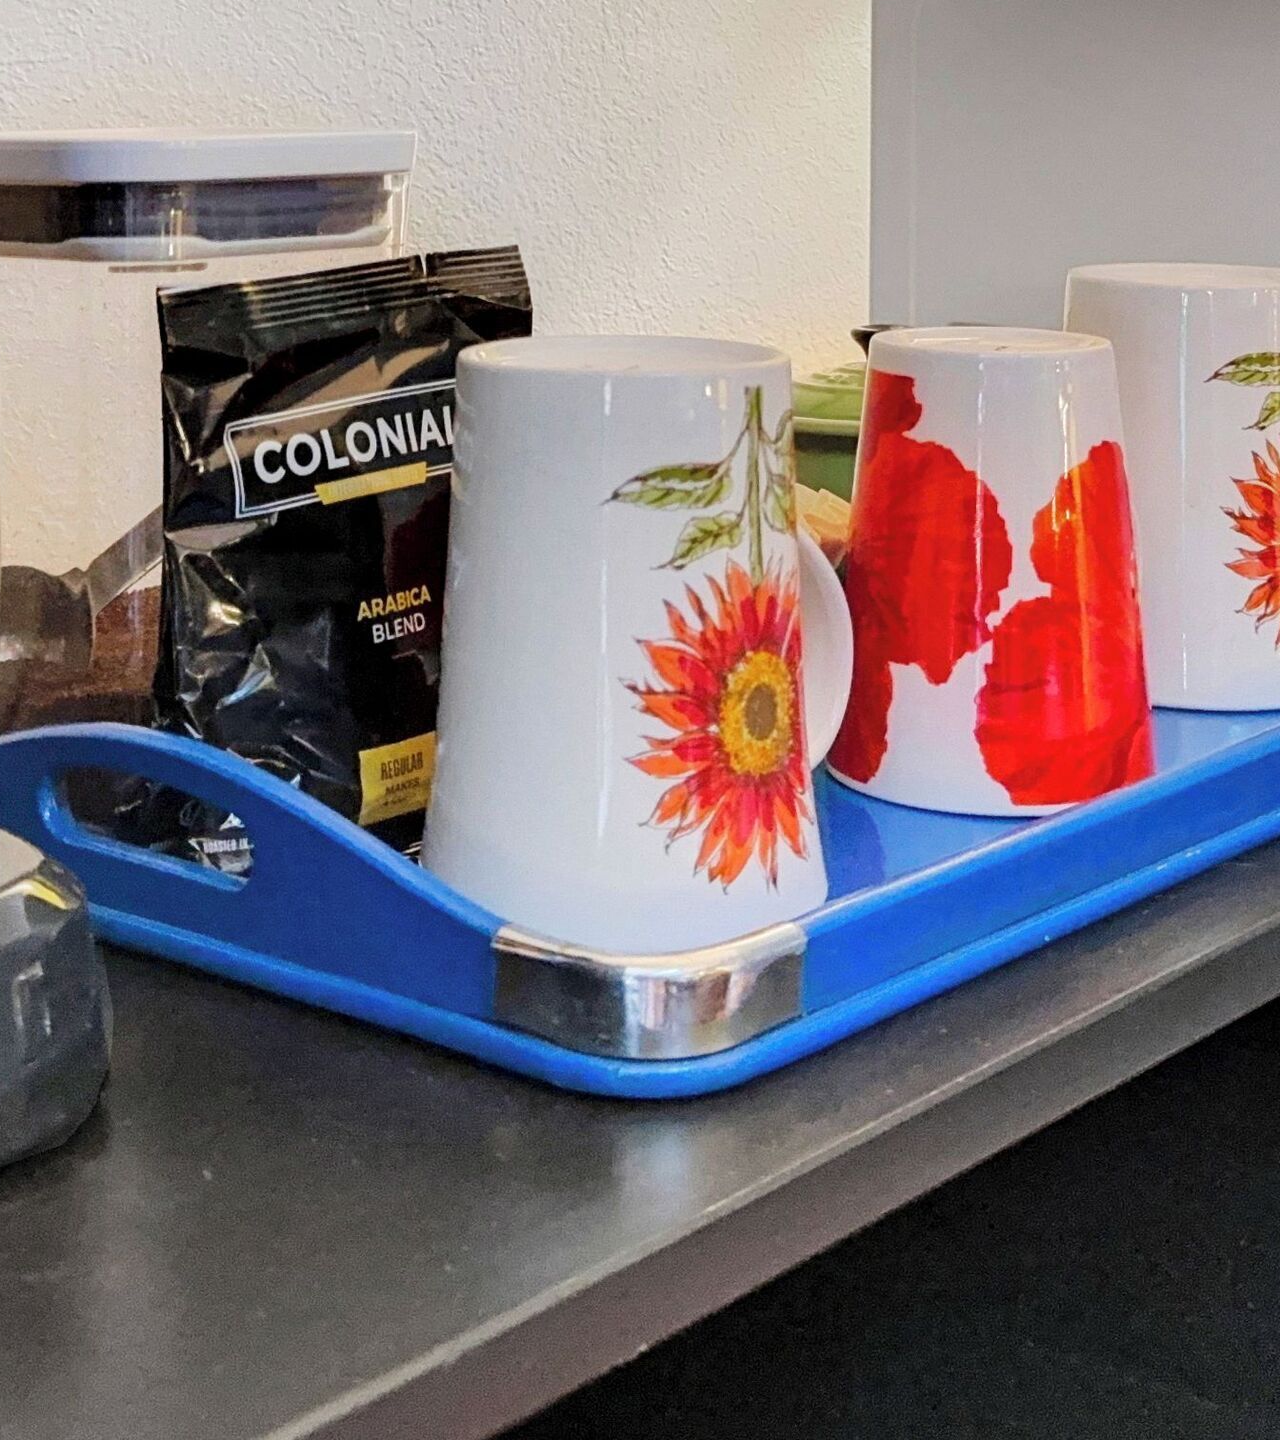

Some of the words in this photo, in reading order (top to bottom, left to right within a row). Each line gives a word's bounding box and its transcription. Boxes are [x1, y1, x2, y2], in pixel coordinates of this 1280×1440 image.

[357, 584, 432, 622] ARABICA
[372, 612, 426, 644] BLEND
[380, 751, 424, 781] REGULAR
